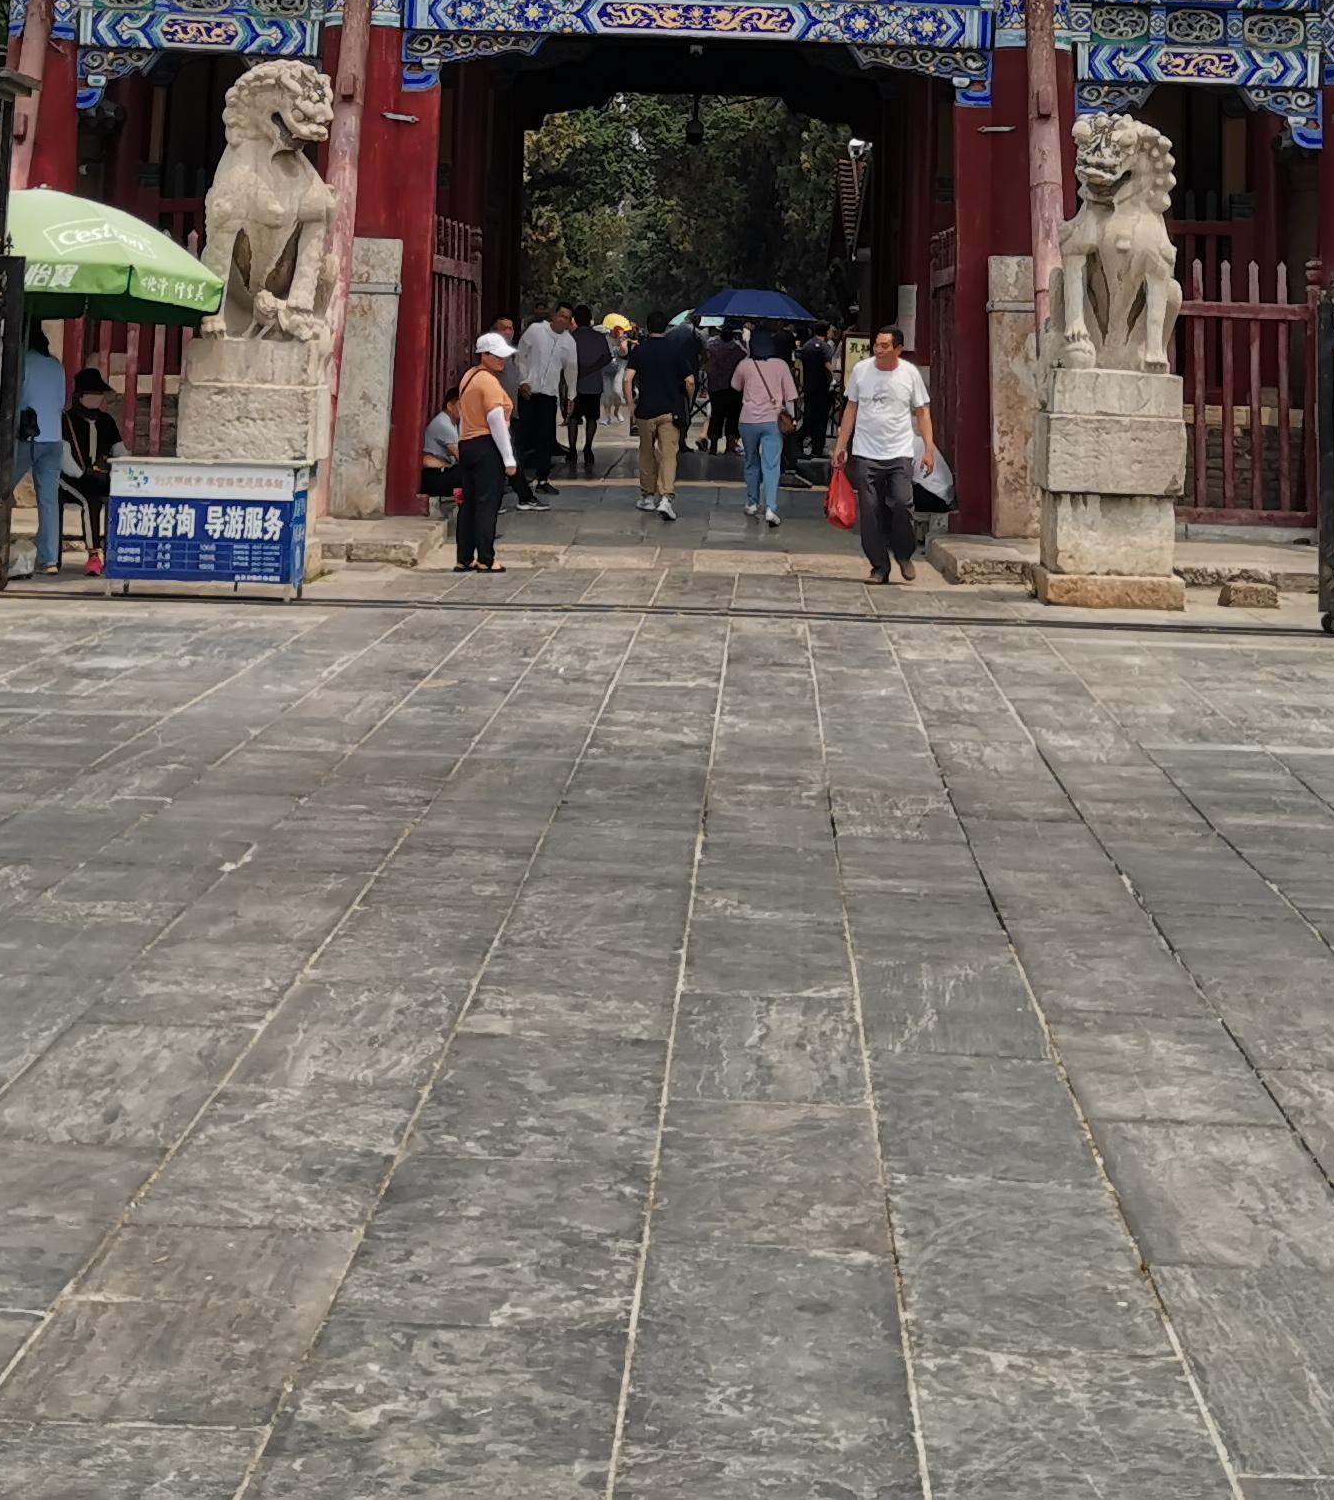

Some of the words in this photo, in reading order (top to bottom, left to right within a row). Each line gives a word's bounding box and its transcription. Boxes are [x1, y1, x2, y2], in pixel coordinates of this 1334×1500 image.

[117, 501, 196, 540] 旅游咨询
[205, 505, 284, 541] 导游服务
